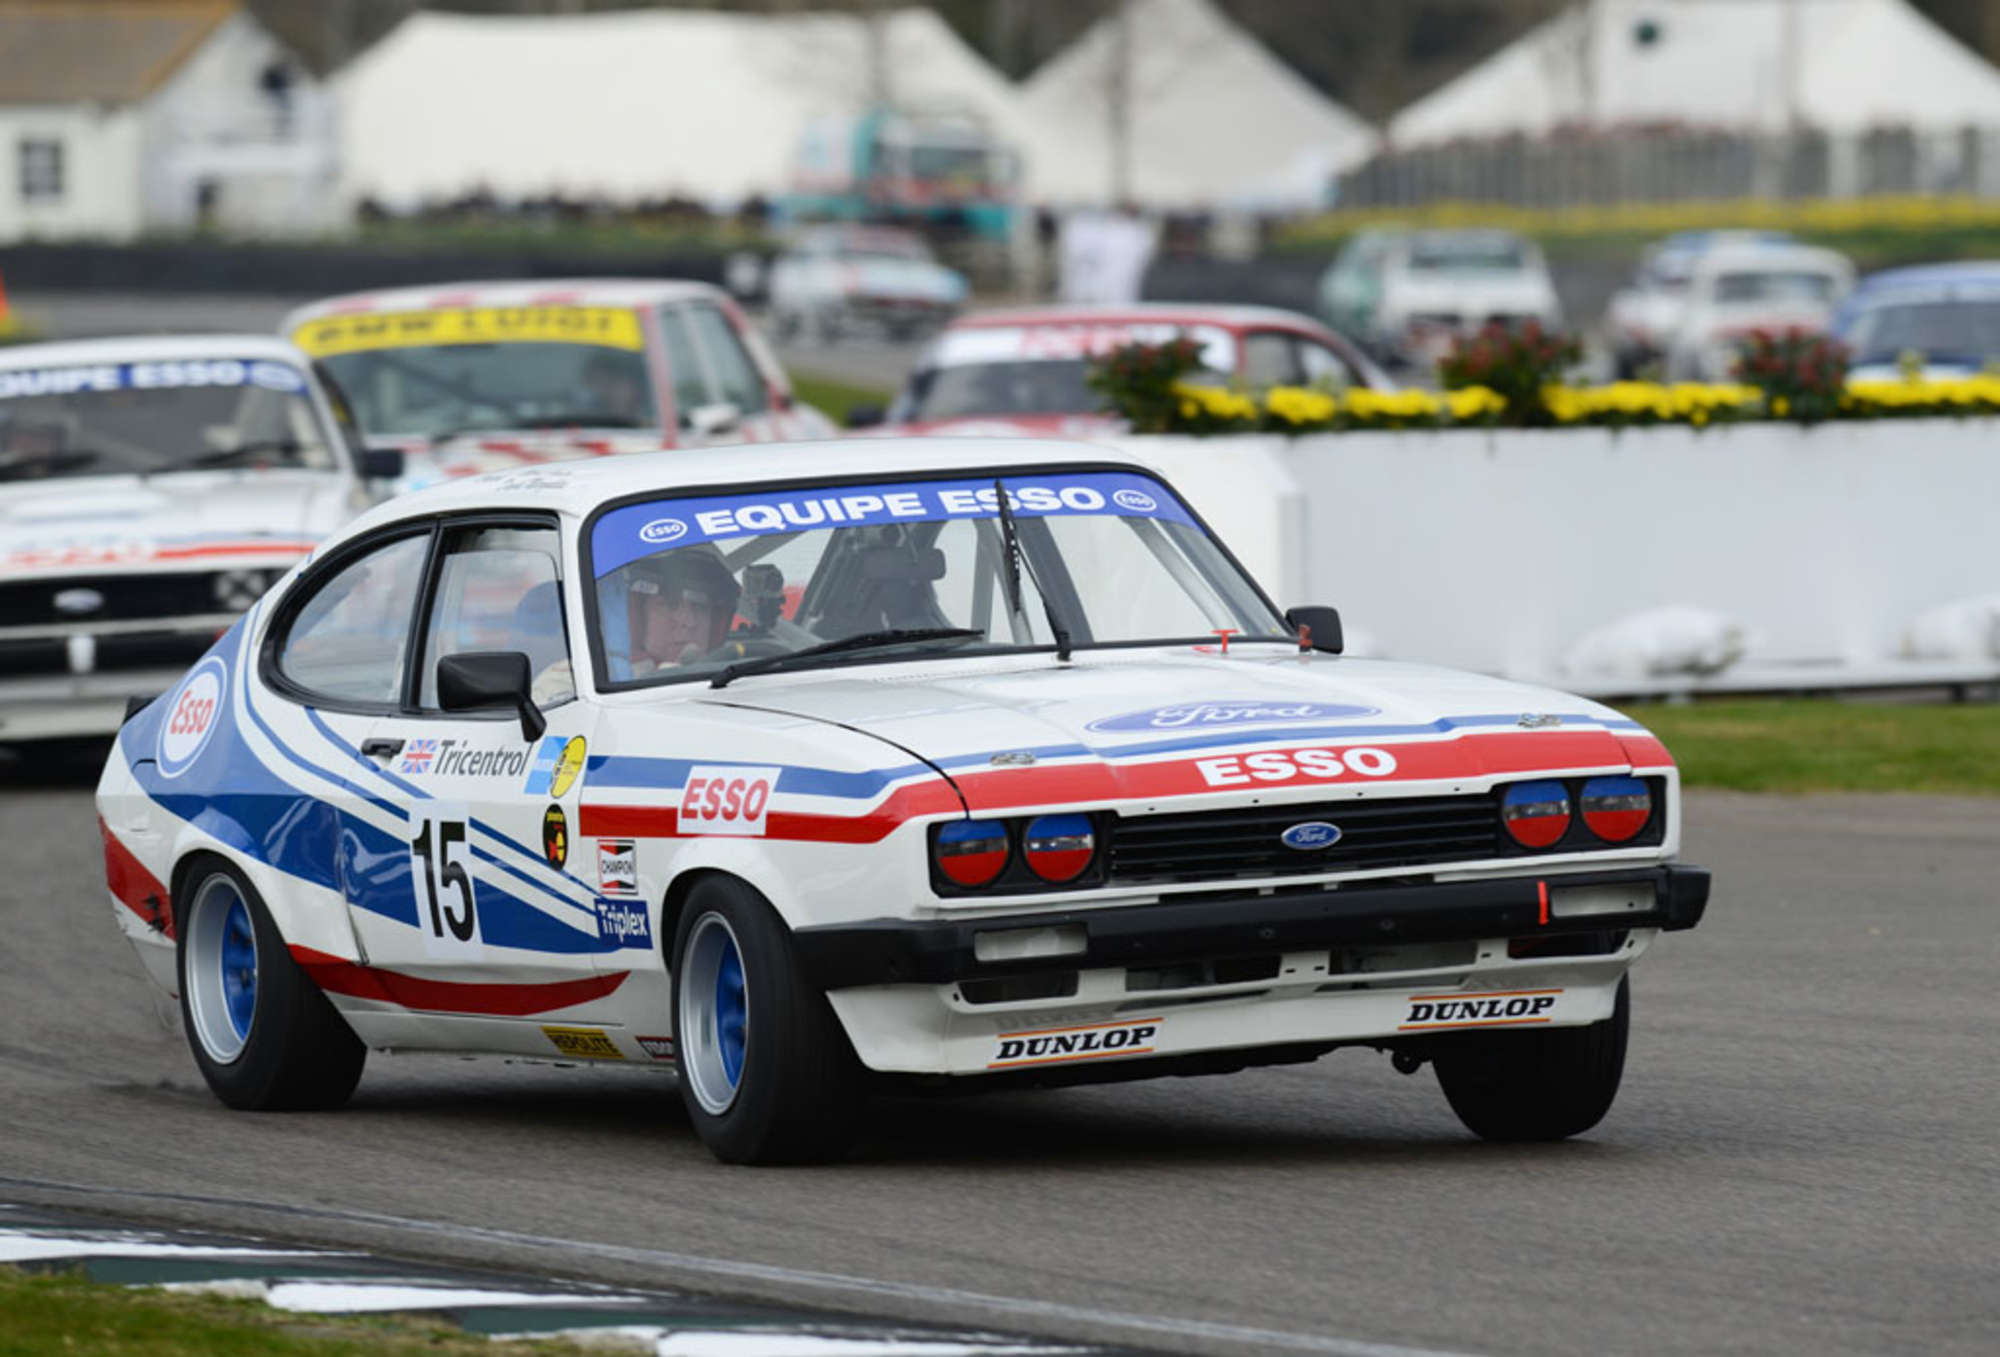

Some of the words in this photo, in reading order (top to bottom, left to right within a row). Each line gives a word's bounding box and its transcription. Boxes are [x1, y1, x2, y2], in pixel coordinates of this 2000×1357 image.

[131, 360, 244, 387] ESSO
[695, 492, 927, 535] EQUIPE
[938, 487, 1105, 514] ESSO
[170, 690, 213, 734] Esso
[1151, 704, 1322, 727] Ford
[435, 739, 534, 776] Tricentrol
[1196, 748, 1397, 786] ESSO
[681, 778, 769, 822] ESSO
[1296, 825, 1330, 842] Ford
[412, 818, 475, 942] 15
[597, 903, 648, 943] Triplex
[1406, 997, 1556, 1022] DUNLOP
[997, 1026, 1156, 1060] DUNLOP
